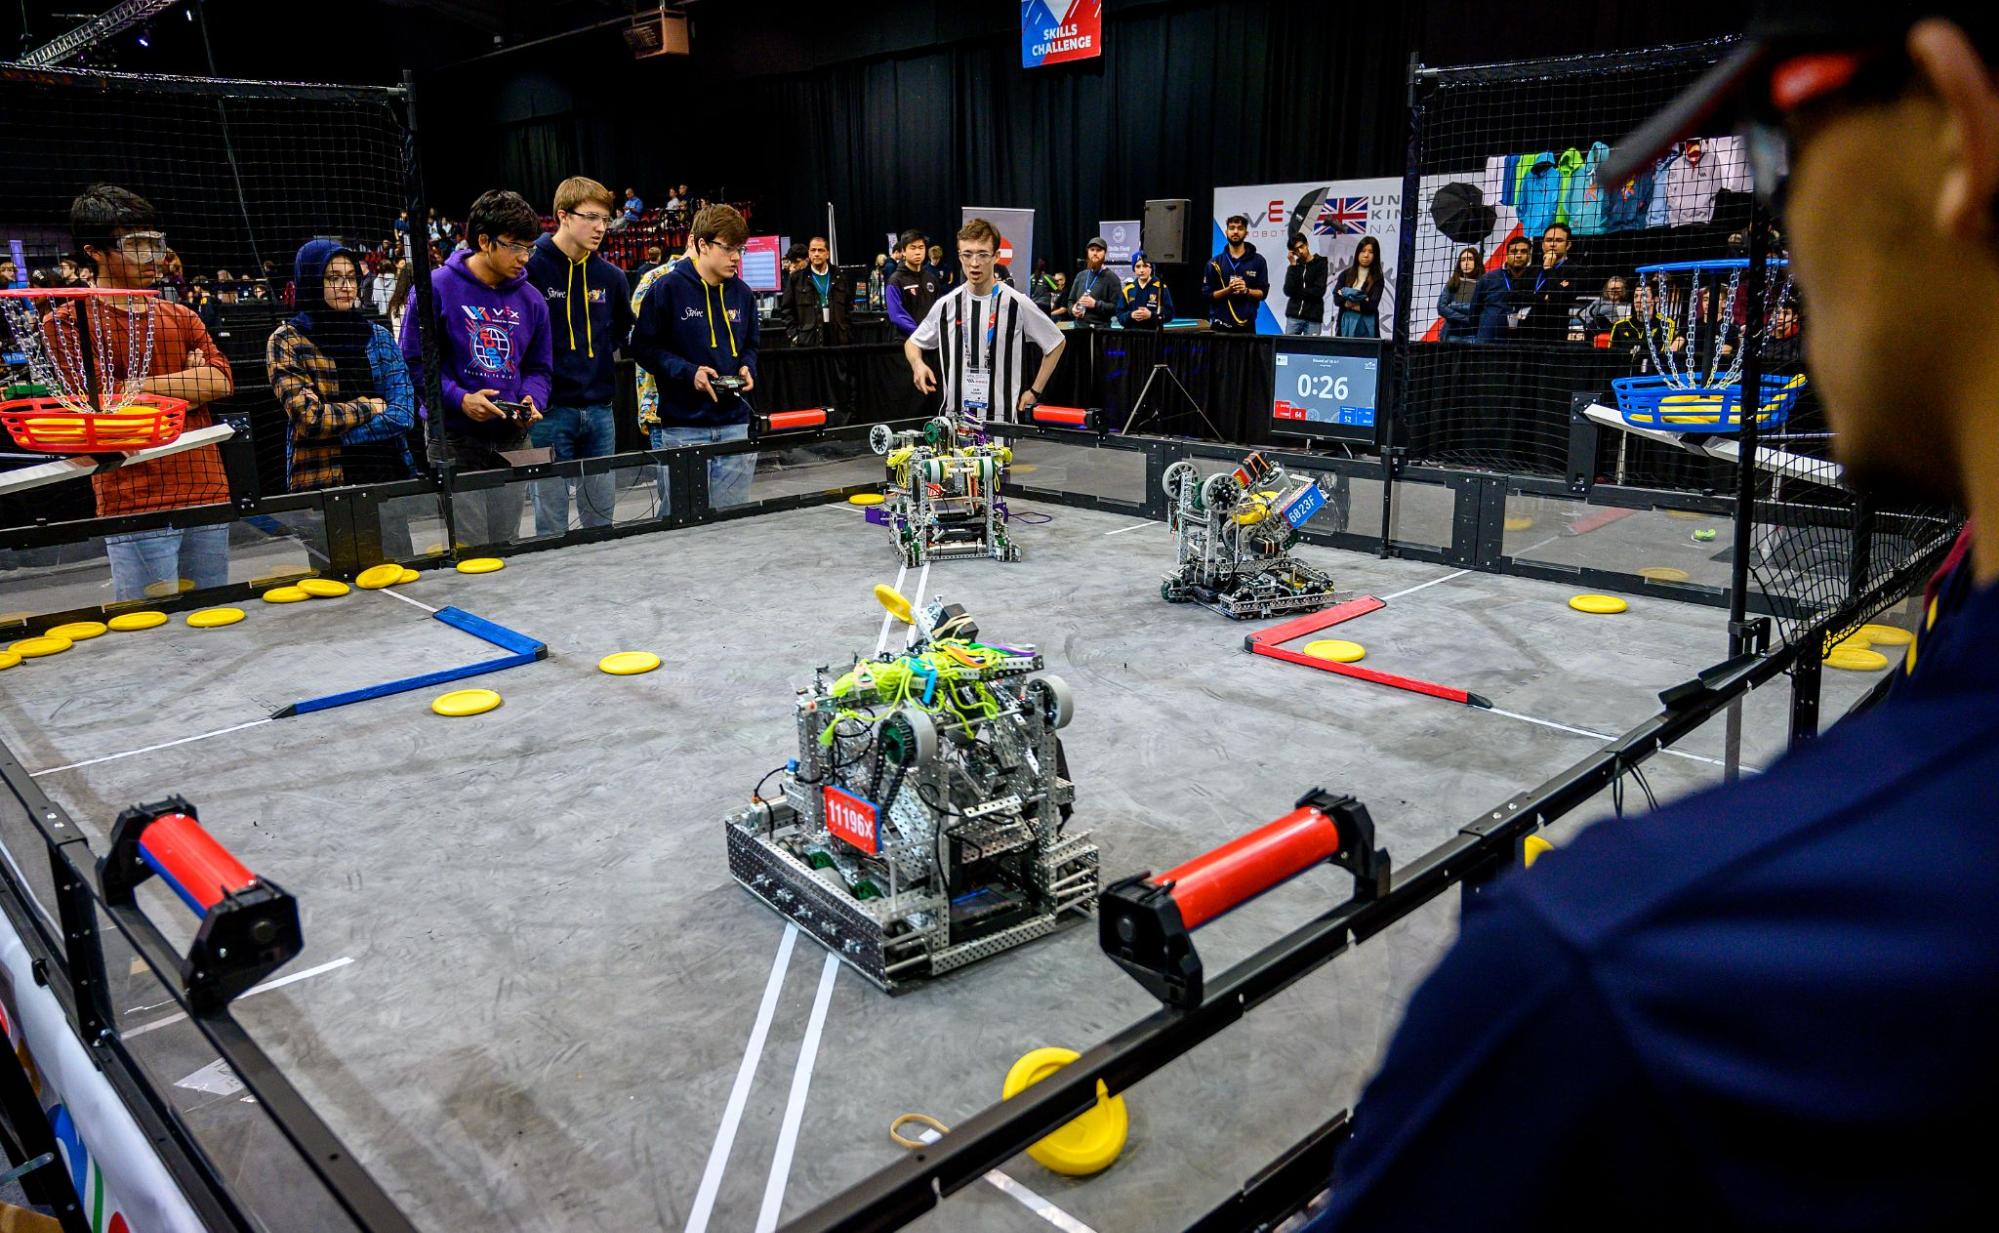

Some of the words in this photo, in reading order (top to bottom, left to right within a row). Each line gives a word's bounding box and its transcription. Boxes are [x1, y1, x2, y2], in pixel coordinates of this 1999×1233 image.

[1043, 24, 1078, 40] SKILLS
[1032, 35, 1092, 56] CHALLENGE
[1242, 200, 1292, 228] VE
[1297, 373, 1349, 400] 0:26
